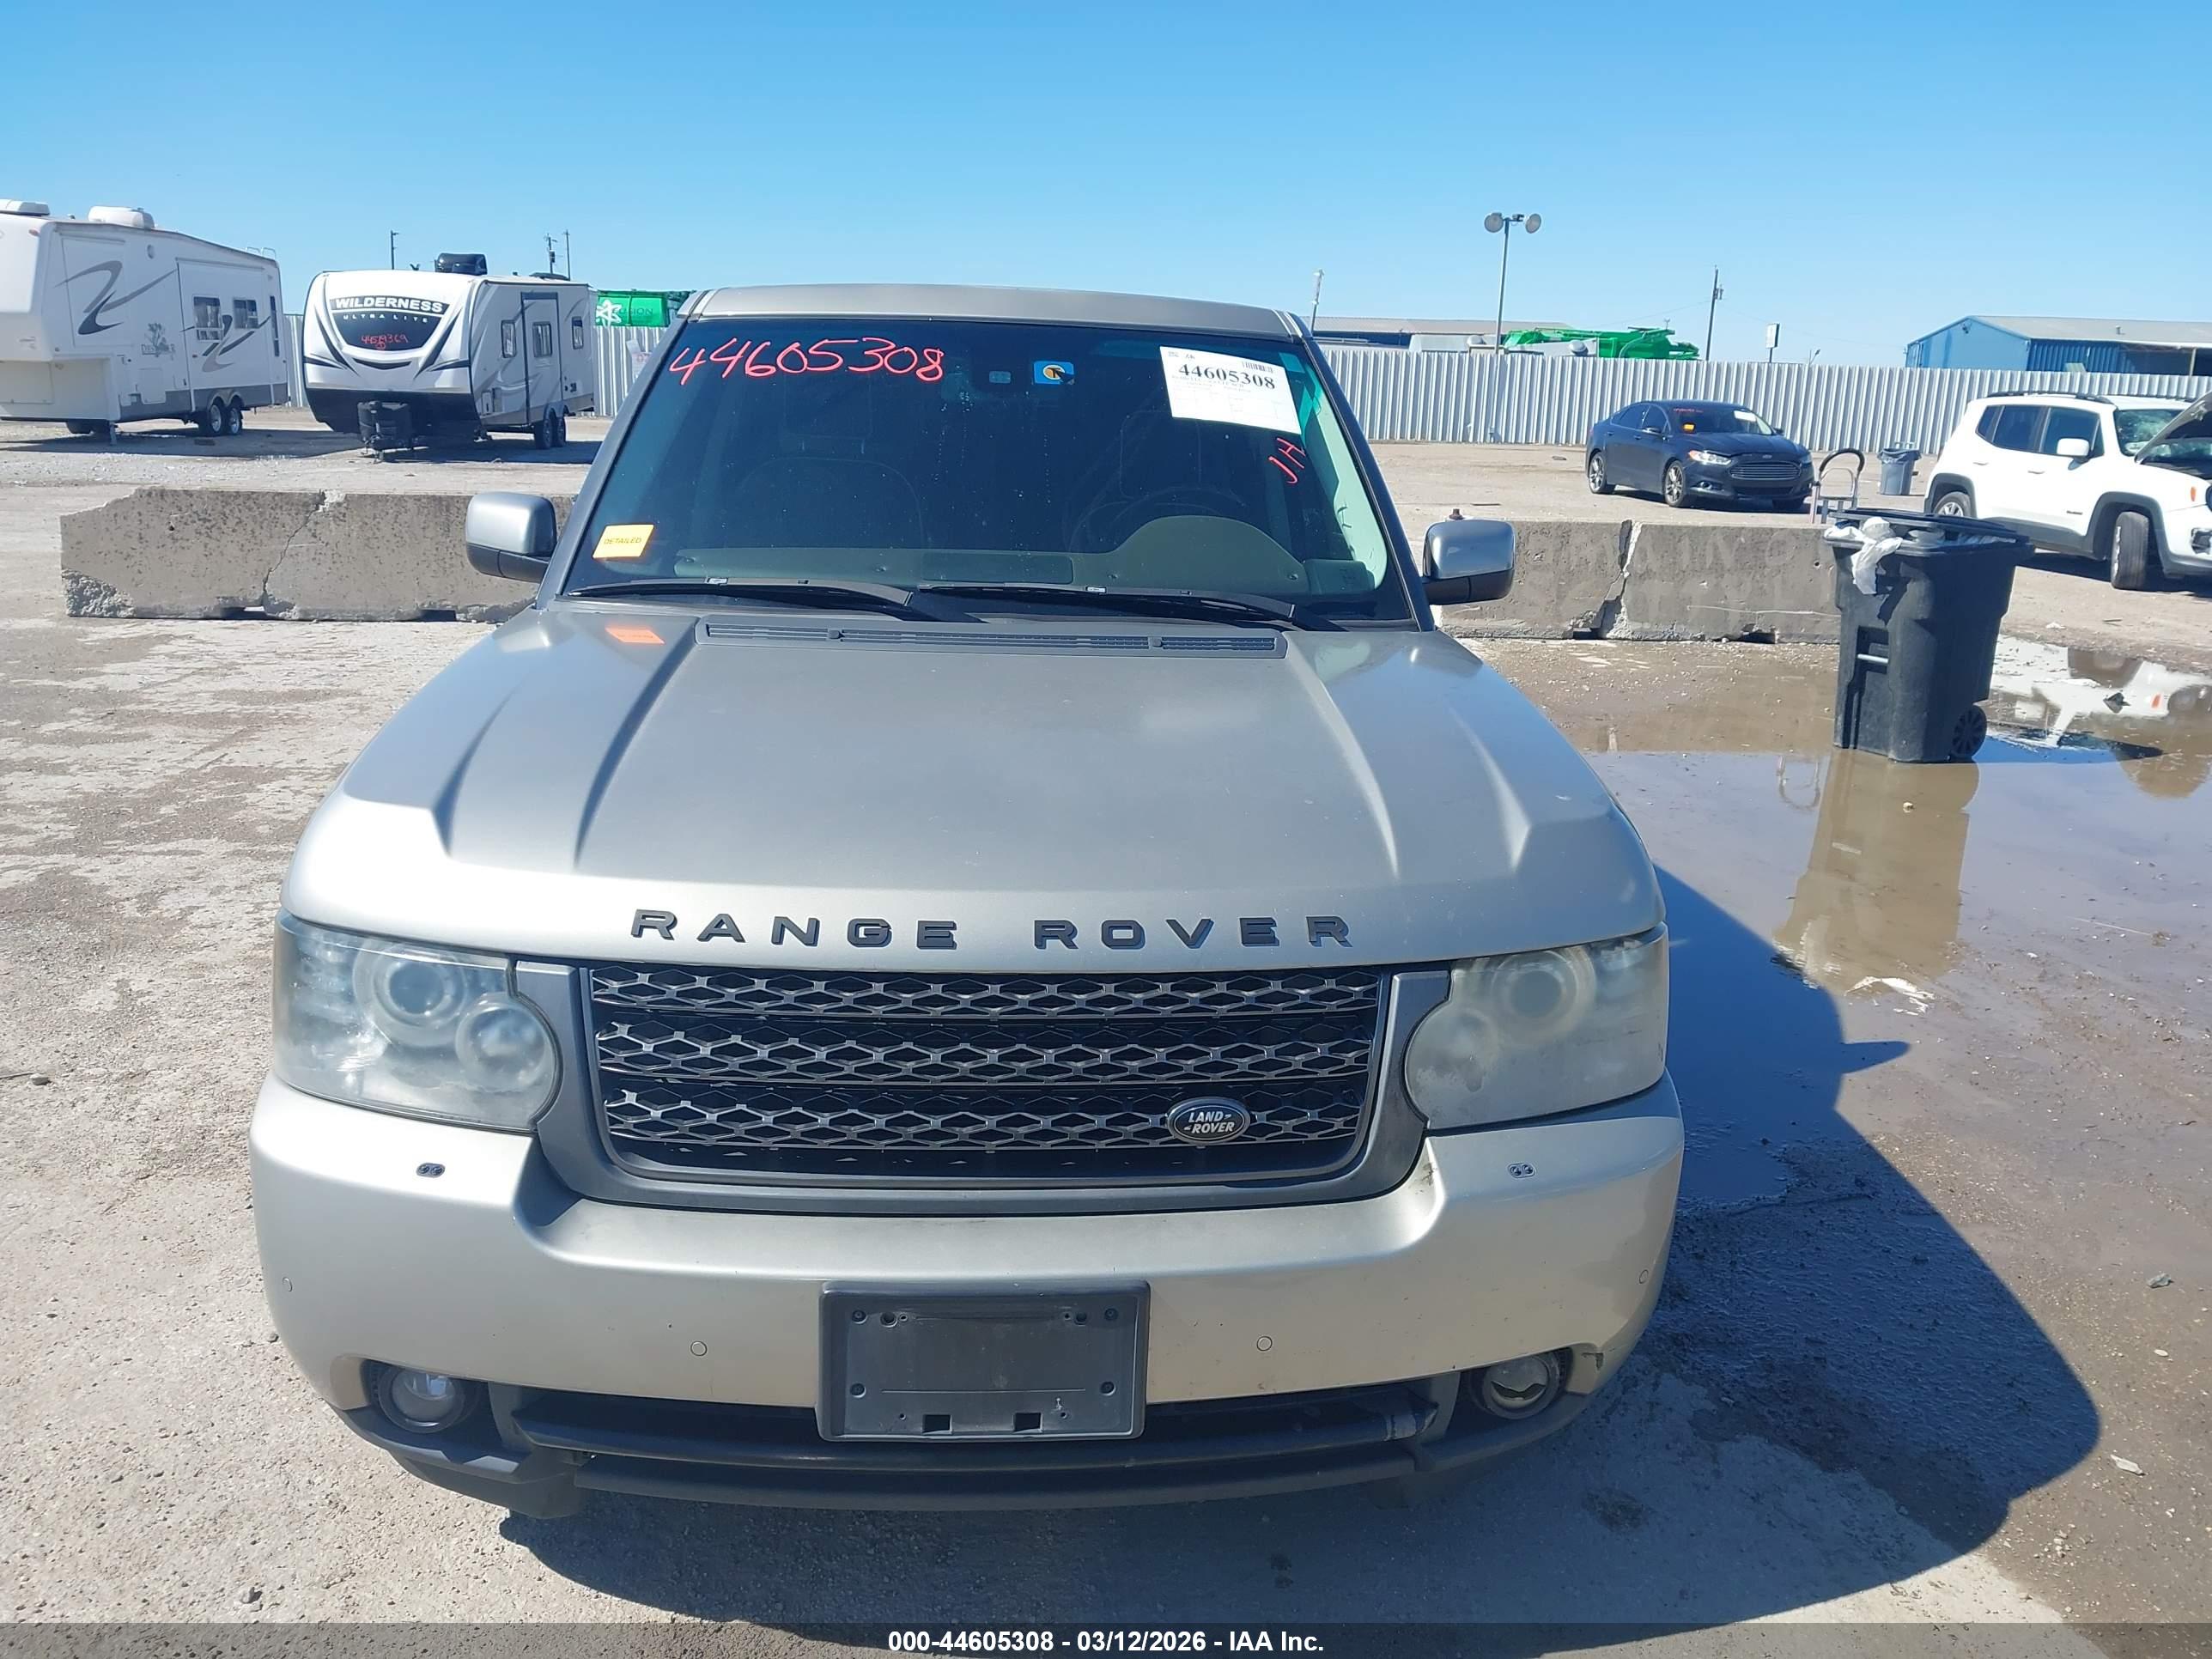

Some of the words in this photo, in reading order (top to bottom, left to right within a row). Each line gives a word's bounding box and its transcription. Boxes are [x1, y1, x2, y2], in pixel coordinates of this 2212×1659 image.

[336, 298, 441, 312] WILDERNESS
[669, 337, 945, 385] 44605308
[1178, 363, 1276, 390] 44605308
[605, 537, 641, 545] DETAILED
[629, 908, 958, 951] RANGE
[1034, 914, 1354, 951] ROVER
[1188, 1110, 1224, 1123] LAND
[1191, 1121, 1236, 1134] ROVER
